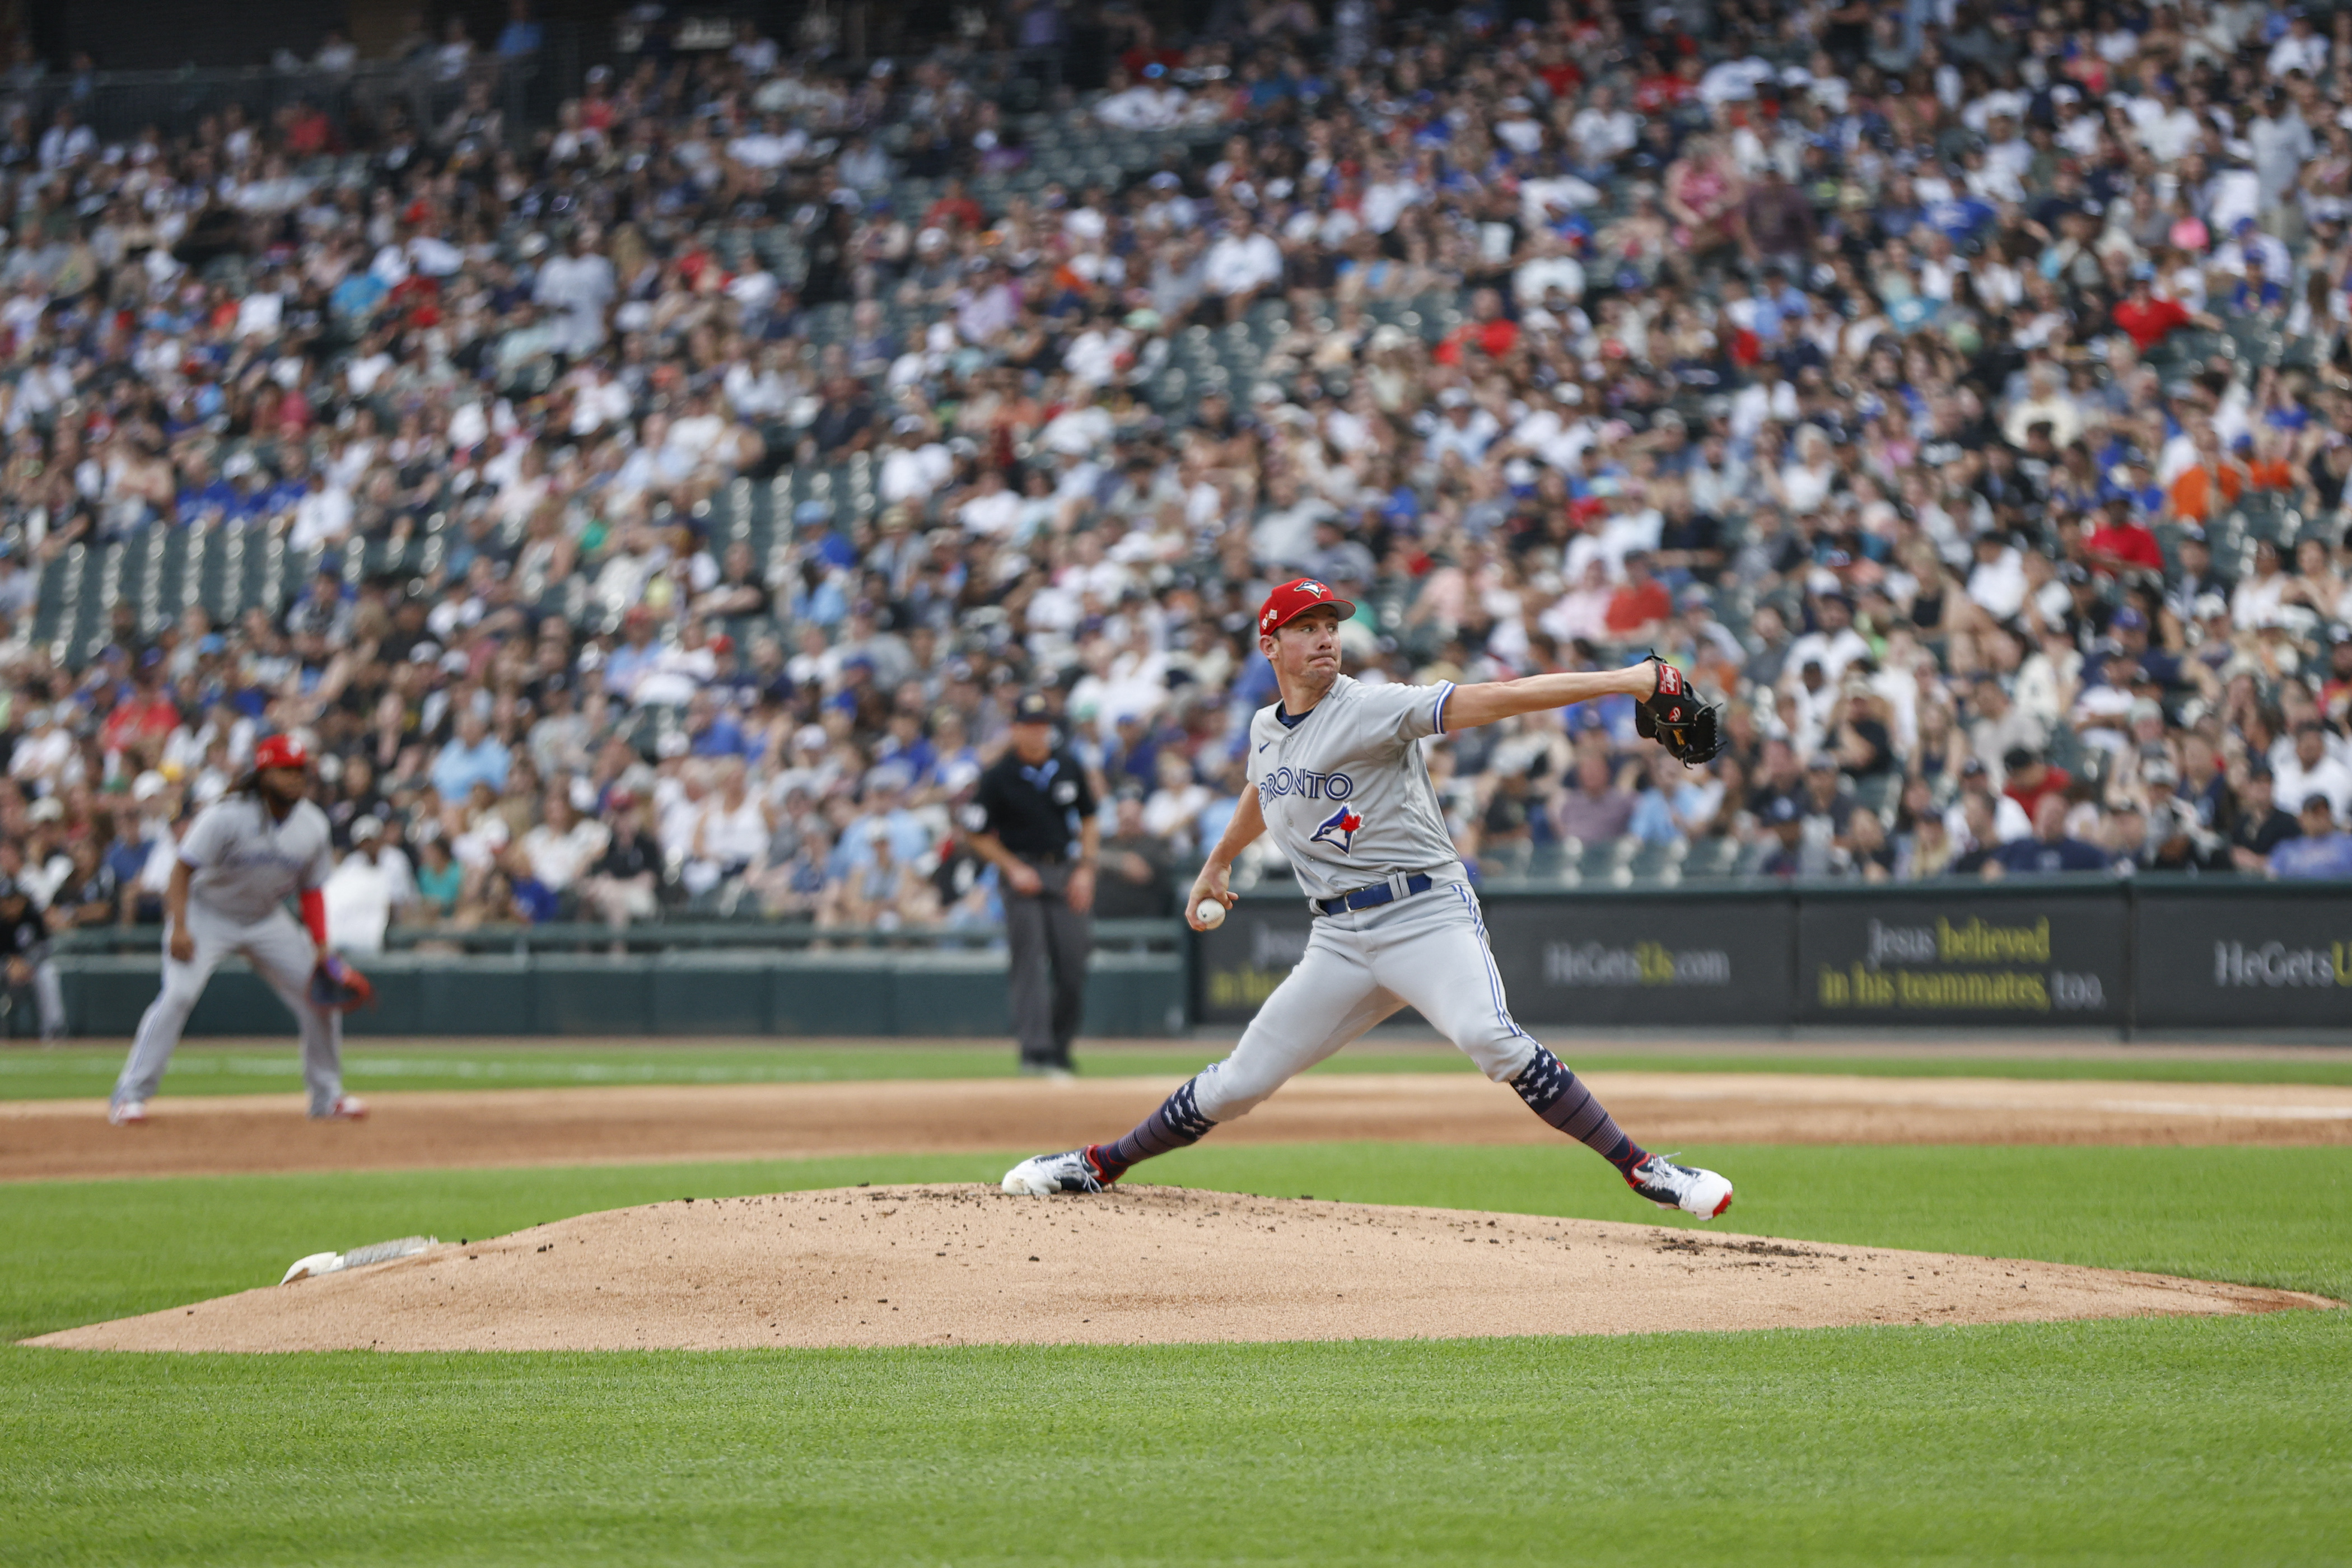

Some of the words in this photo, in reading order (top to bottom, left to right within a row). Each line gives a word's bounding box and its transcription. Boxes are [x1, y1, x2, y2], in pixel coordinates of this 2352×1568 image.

[1259, 767, 1353, 810] ORONTO
[1867, 918, 1936, 970] Jesus
[1936, 915, 2051, 964] believed
[1818, 962, 1849, 1007] in
[1850, 960, 1896, 1007] his
